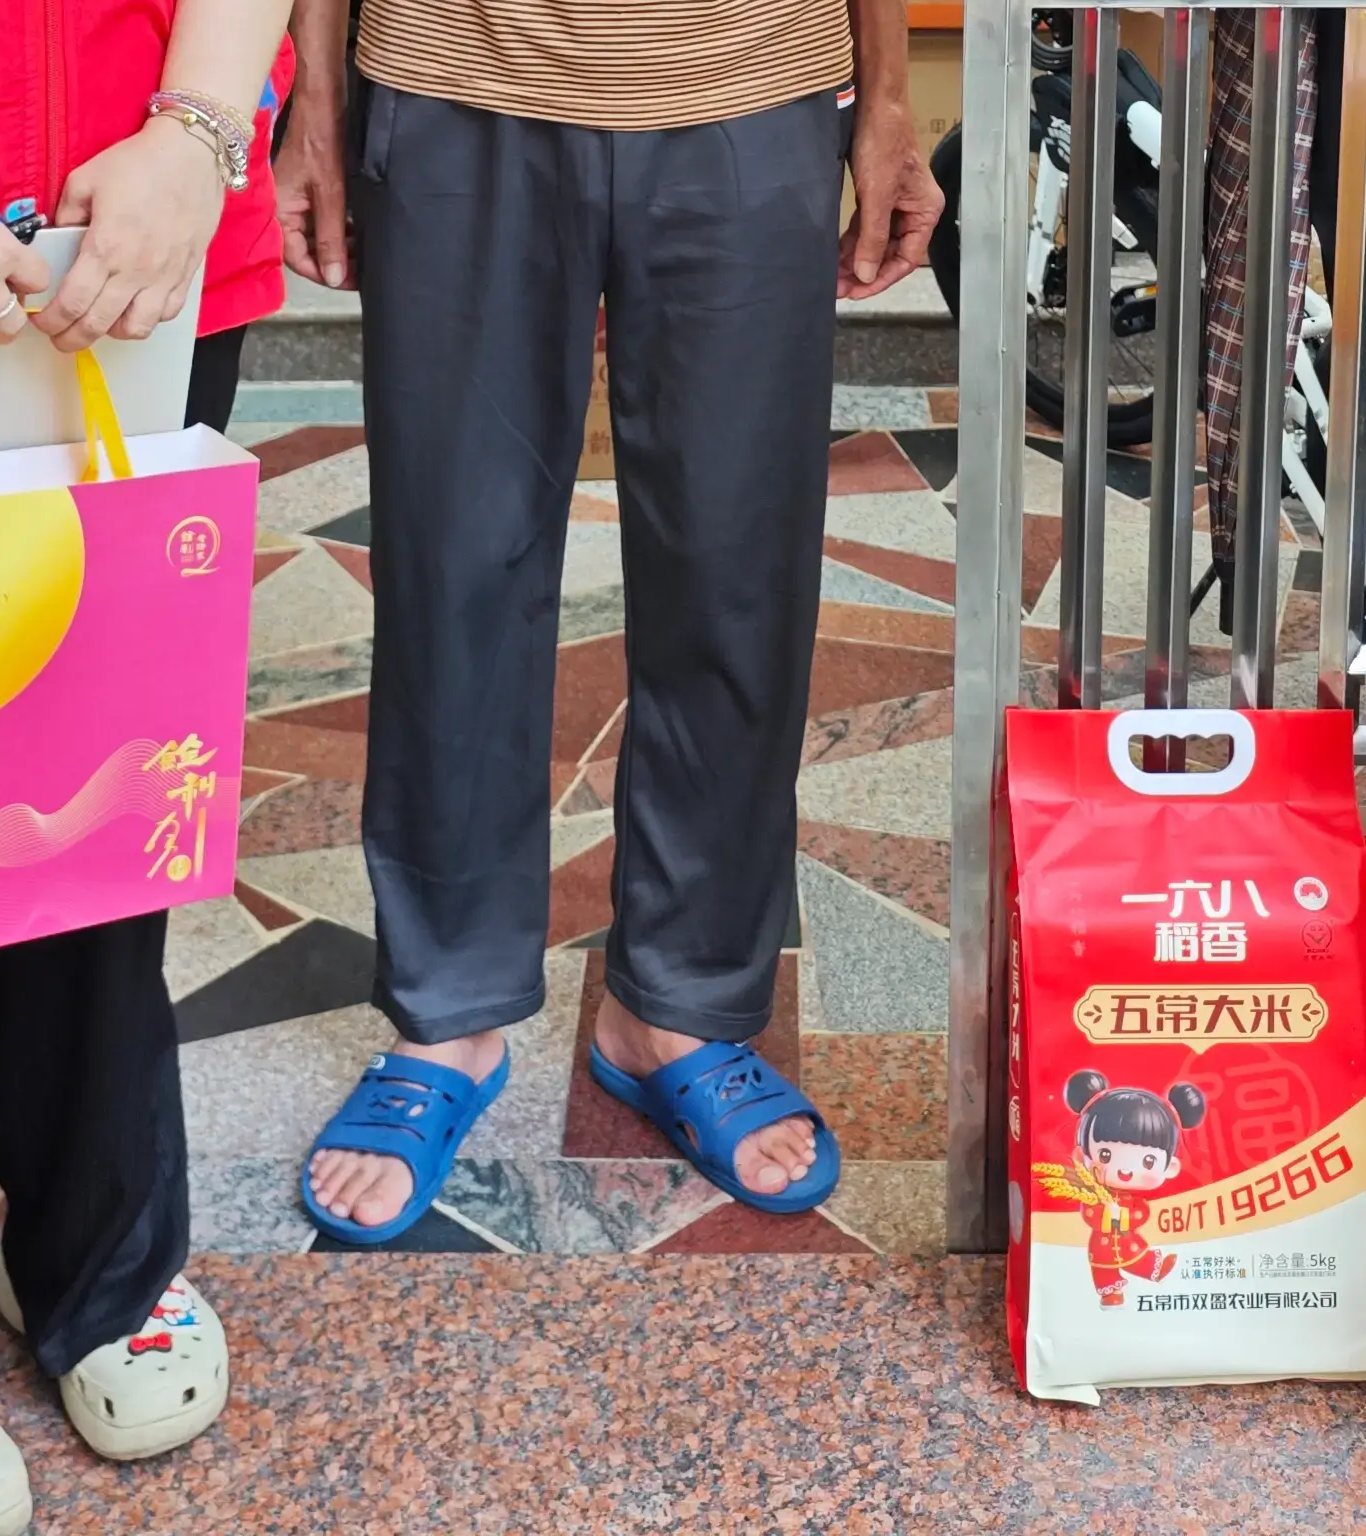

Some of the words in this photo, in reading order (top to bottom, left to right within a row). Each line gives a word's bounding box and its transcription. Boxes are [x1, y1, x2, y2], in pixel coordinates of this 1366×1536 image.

[1121, 879, 1271, 919] 一六八
[1153, 921, 1248, 963] 稻香
[1110, 994, 1293, 1035] 五常大米
[1157, 1199, 1208, 1234] GB/T
[1216, 1132, 1354, 1227] 19266
[1181, 1268, 1247, 1280] 认准执行标准
[1137, 1291, 1338, 1312] 五常市双盈农业有限公司
